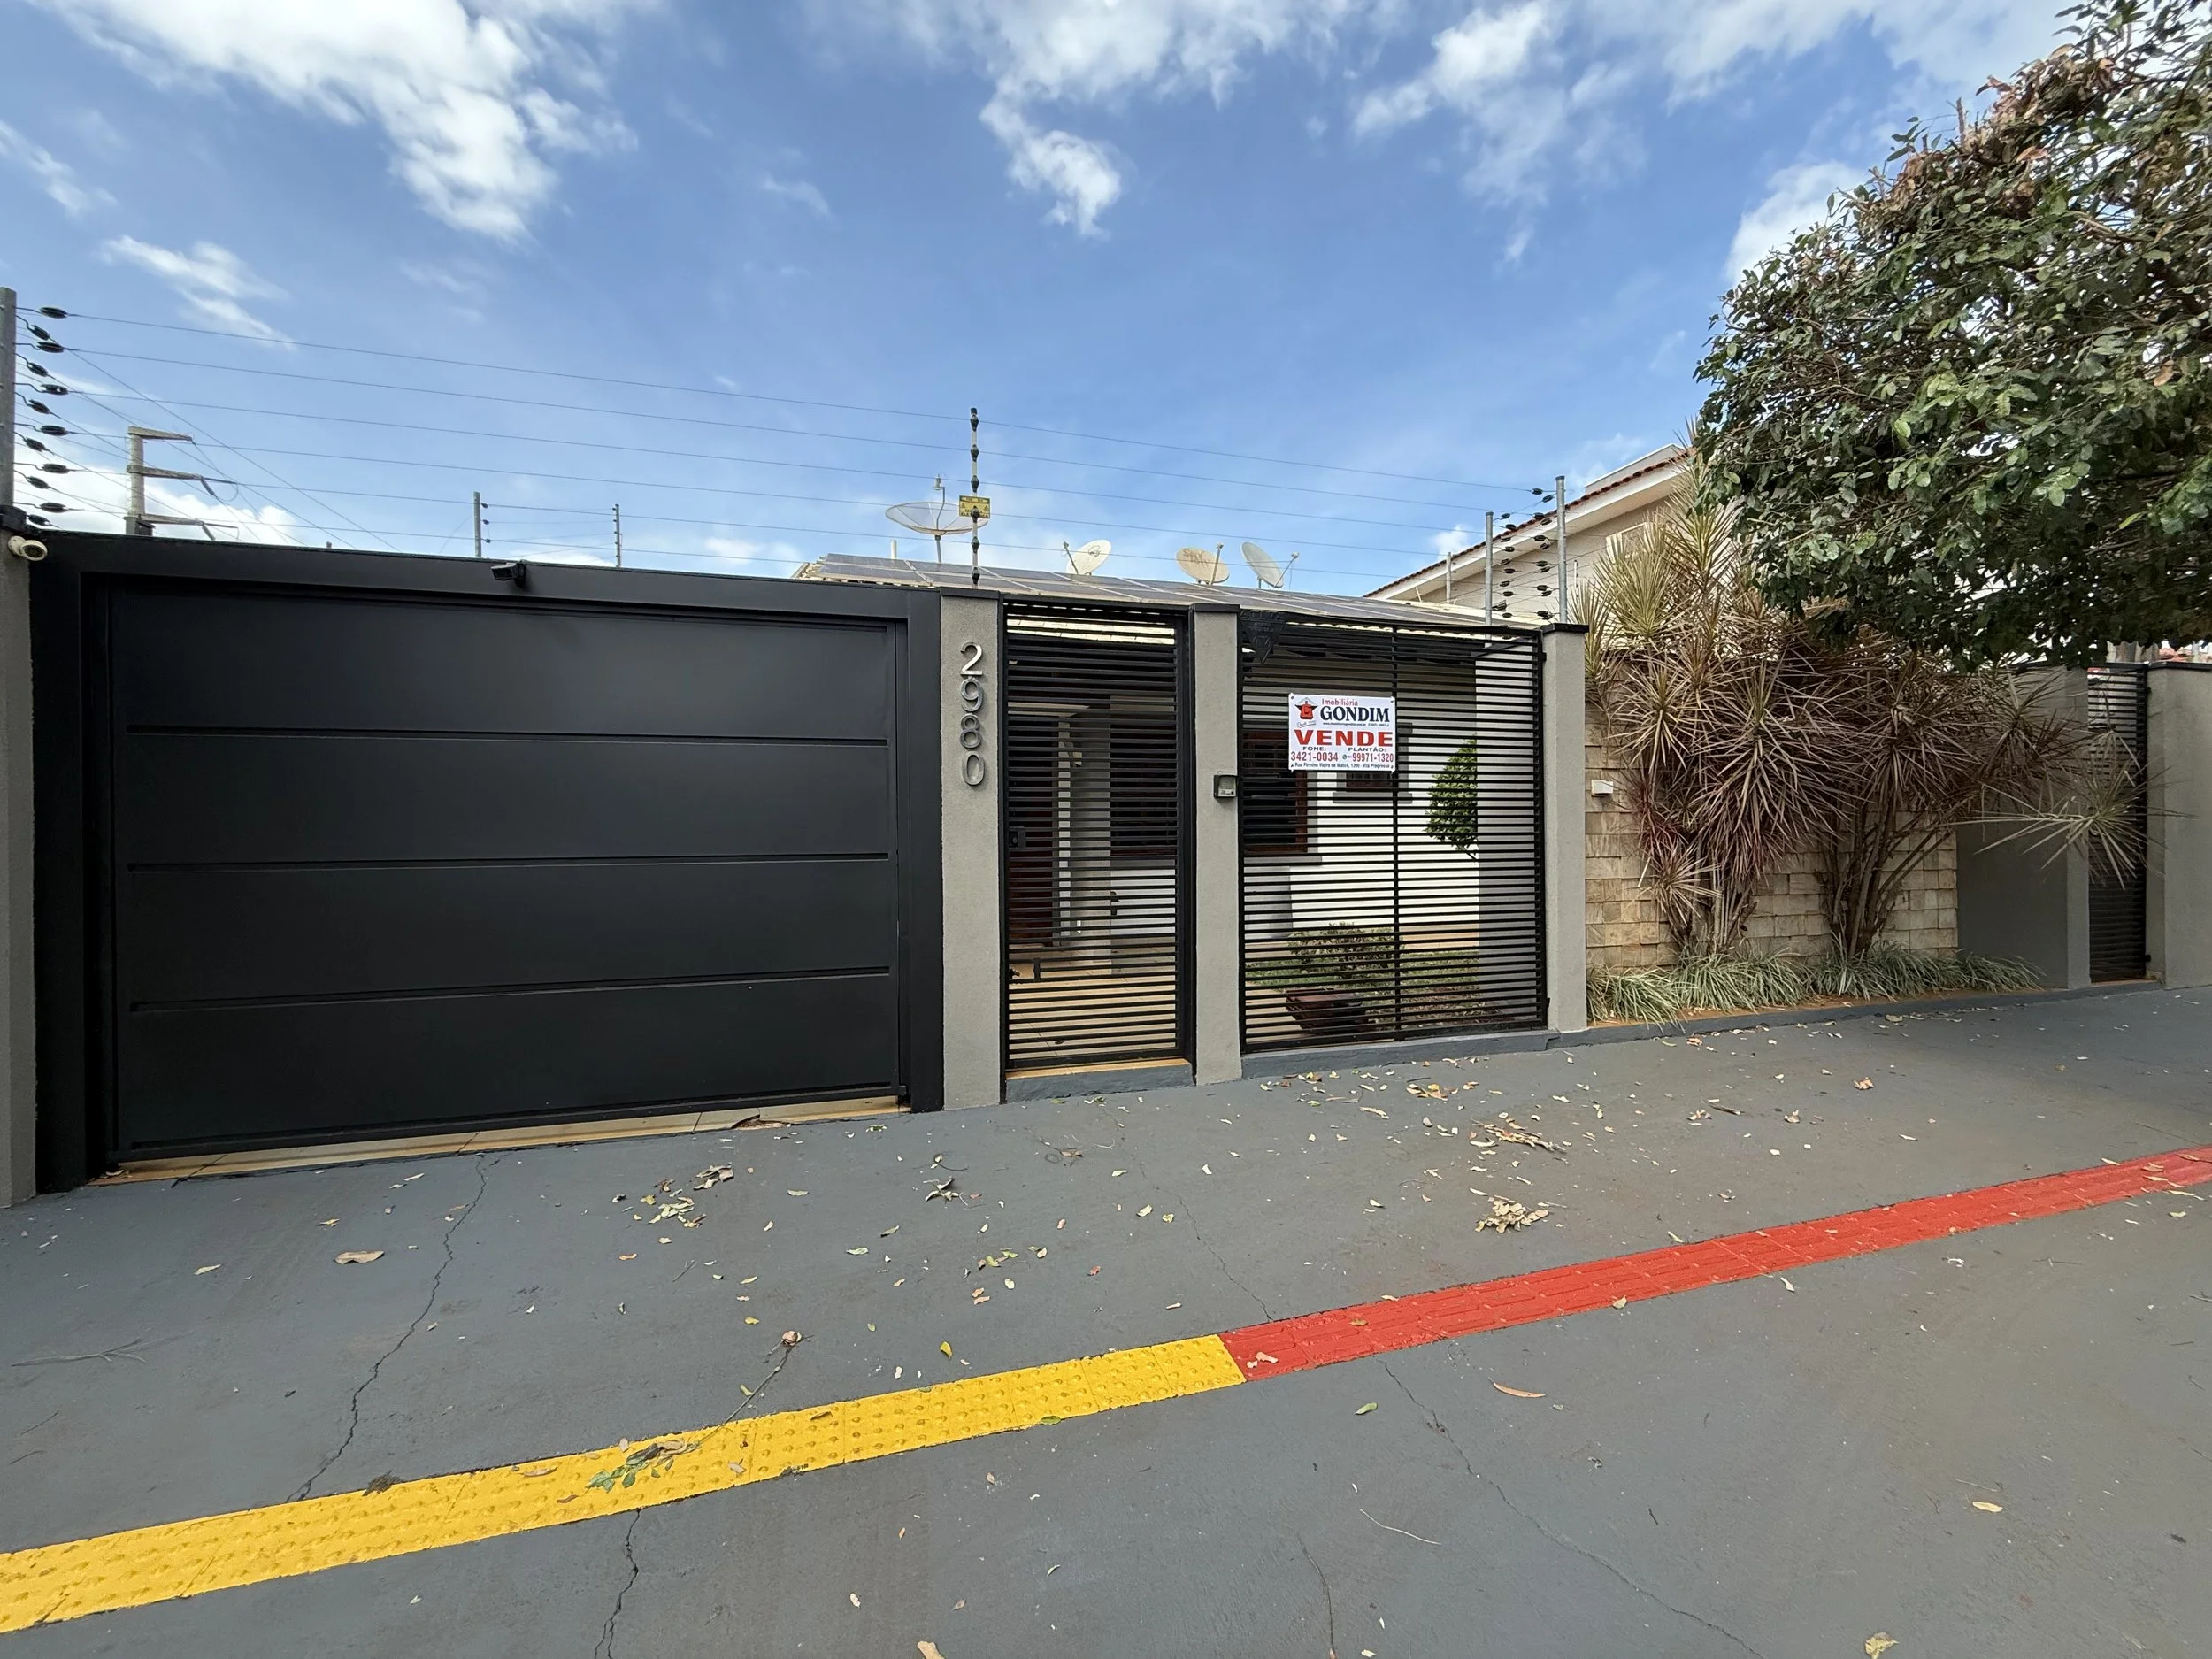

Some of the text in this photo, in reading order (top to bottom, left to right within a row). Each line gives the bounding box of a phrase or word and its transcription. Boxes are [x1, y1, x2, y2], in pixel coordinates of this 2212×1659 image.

[960, 641, 985, 786] 2980
[1320, 706, 1390, 722] GONDIM
[1294, 729, 1394, 747] VENDE
[1291, 752, 1339, 762] 3421-0034
[1352, 752, 1394, 763] 99971-1320
